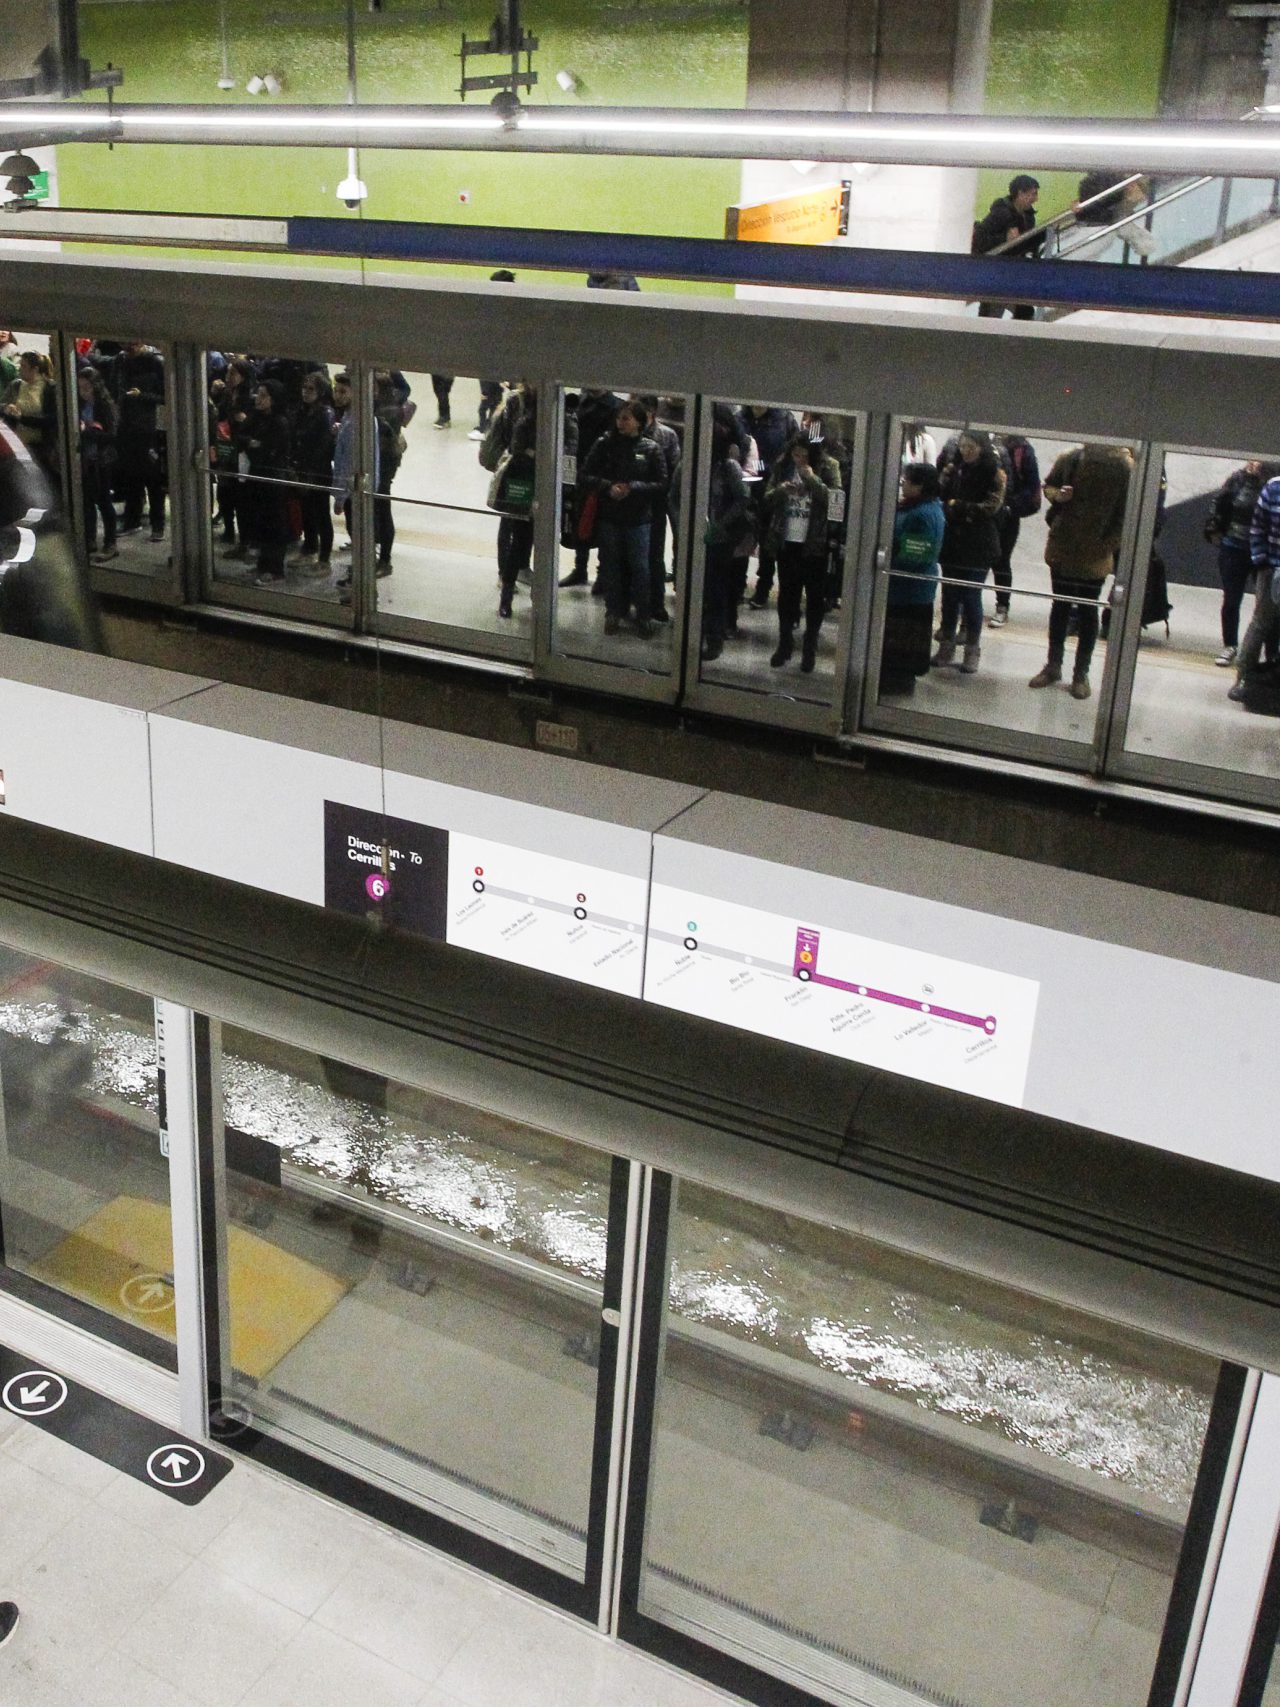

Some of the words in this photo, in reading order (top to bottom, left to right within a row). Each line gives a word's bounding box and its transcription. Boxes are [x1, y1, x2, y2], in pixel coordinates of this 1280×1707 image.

[347, 849, 397, 871] Cerrills
[409, 851, 423, 865] To
[372, 880, 385, 897] 6
